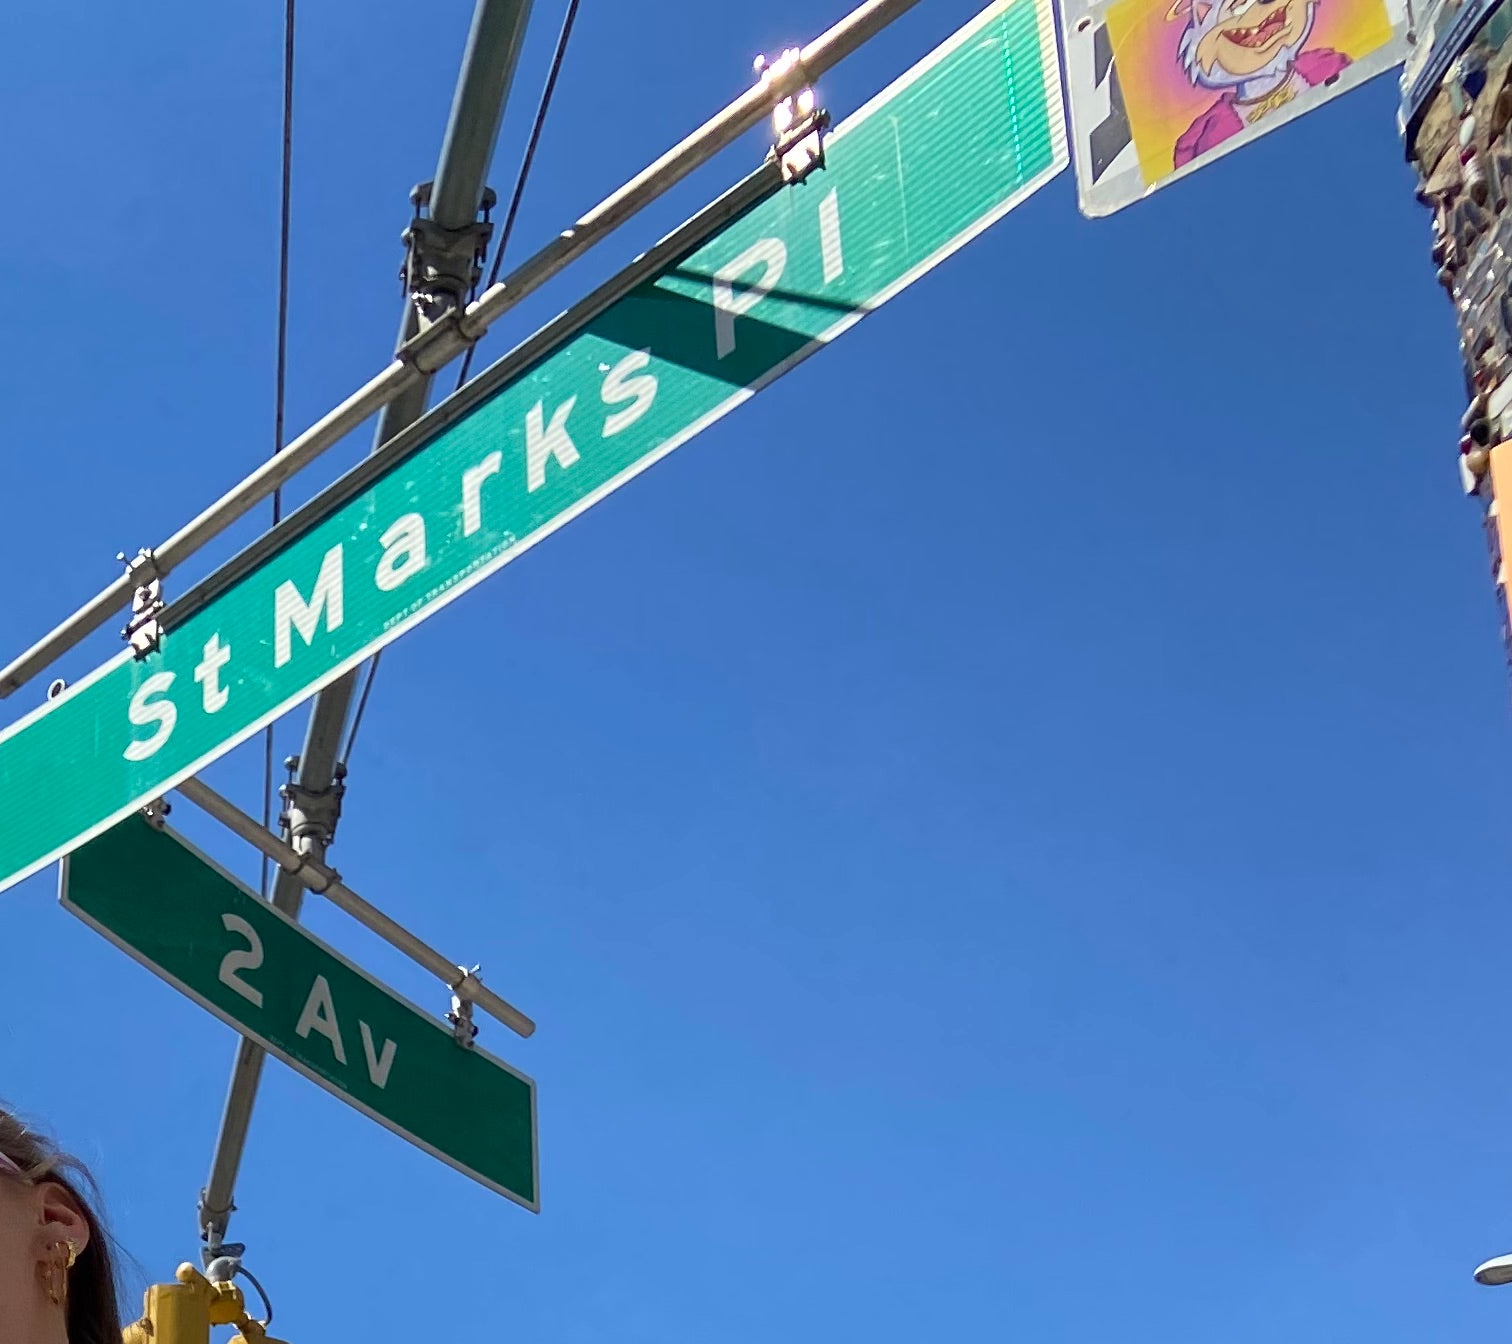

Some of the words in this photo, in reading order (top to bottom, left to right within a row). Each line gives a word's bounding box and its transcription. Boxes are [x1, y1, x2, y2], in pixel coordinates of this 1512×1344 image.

[122, 632, 232, 763] St
[273, 345, 660, 669] Marks
[713, 187, 844, 360] Pl
[218, 913, 265, 1009] 2
[294, 974, 398, 1090] Av
